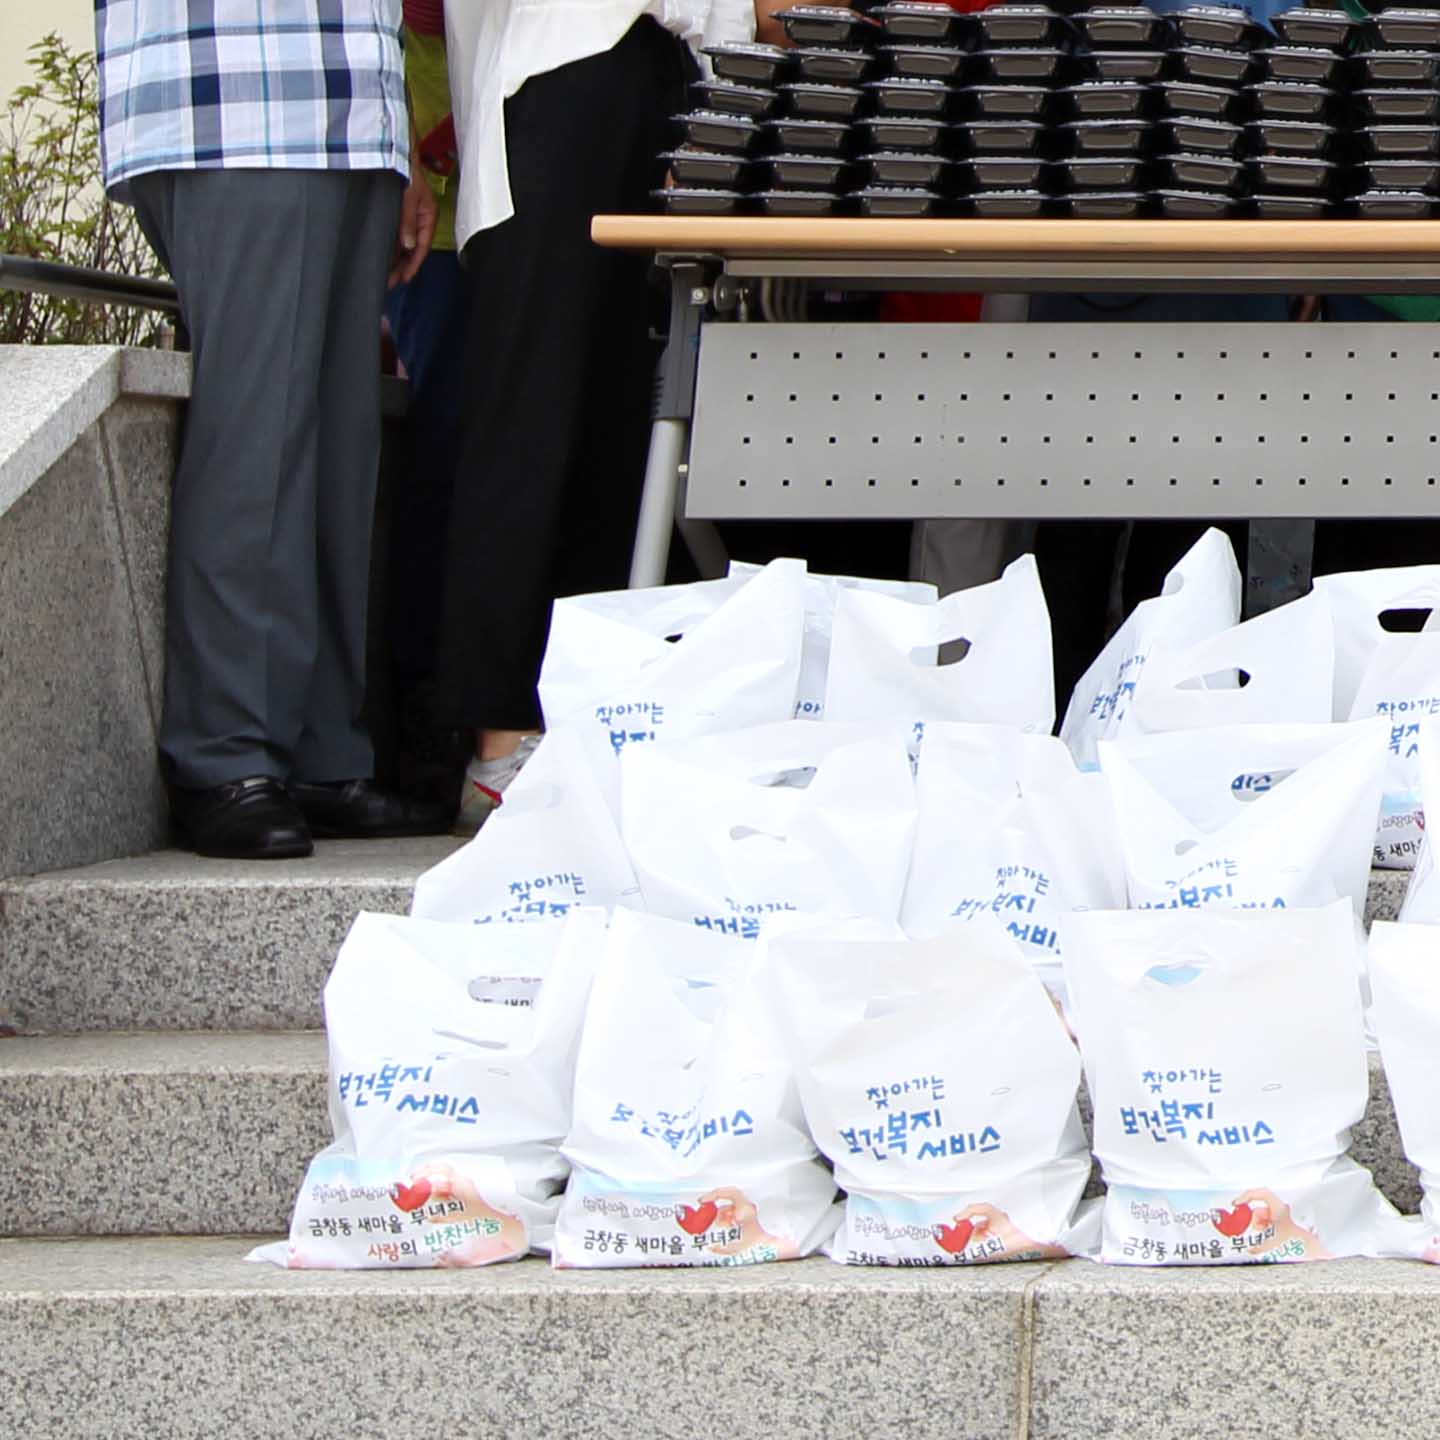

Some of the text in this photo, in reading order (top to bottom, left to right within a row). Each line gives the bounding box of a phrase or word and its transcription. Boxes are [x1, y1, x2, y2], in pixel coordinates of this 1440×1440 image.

[595, 702, 664, 725] 찾아가는
[1390, 838, 1422, 856] 새마
[508, 872, 586, 903] 찾아가는
[1006, 922, 1061, 954] 서비
[339, 1064, 480, 1124] 보건복지 서비스
[866, 1075, 945, 1110] 찾아가는
[1142, 1068, 1223, 1094] 찾아가는
[839, 1109, 1001, 1161] 보건복지 서비스
[1120, 1099, 1275, 1145] 보건복지 서비스
[309, 1201, 465, 1237] 금창동 새마을 부녀회
[368, 1217, 500, 1261] 사랑의 반찬나눔
[584, 1227, 742, 1255] 금창동 새마을 부녀회
[1123, 1224, 1276, 1260] 금창동 새마을 부녀회
